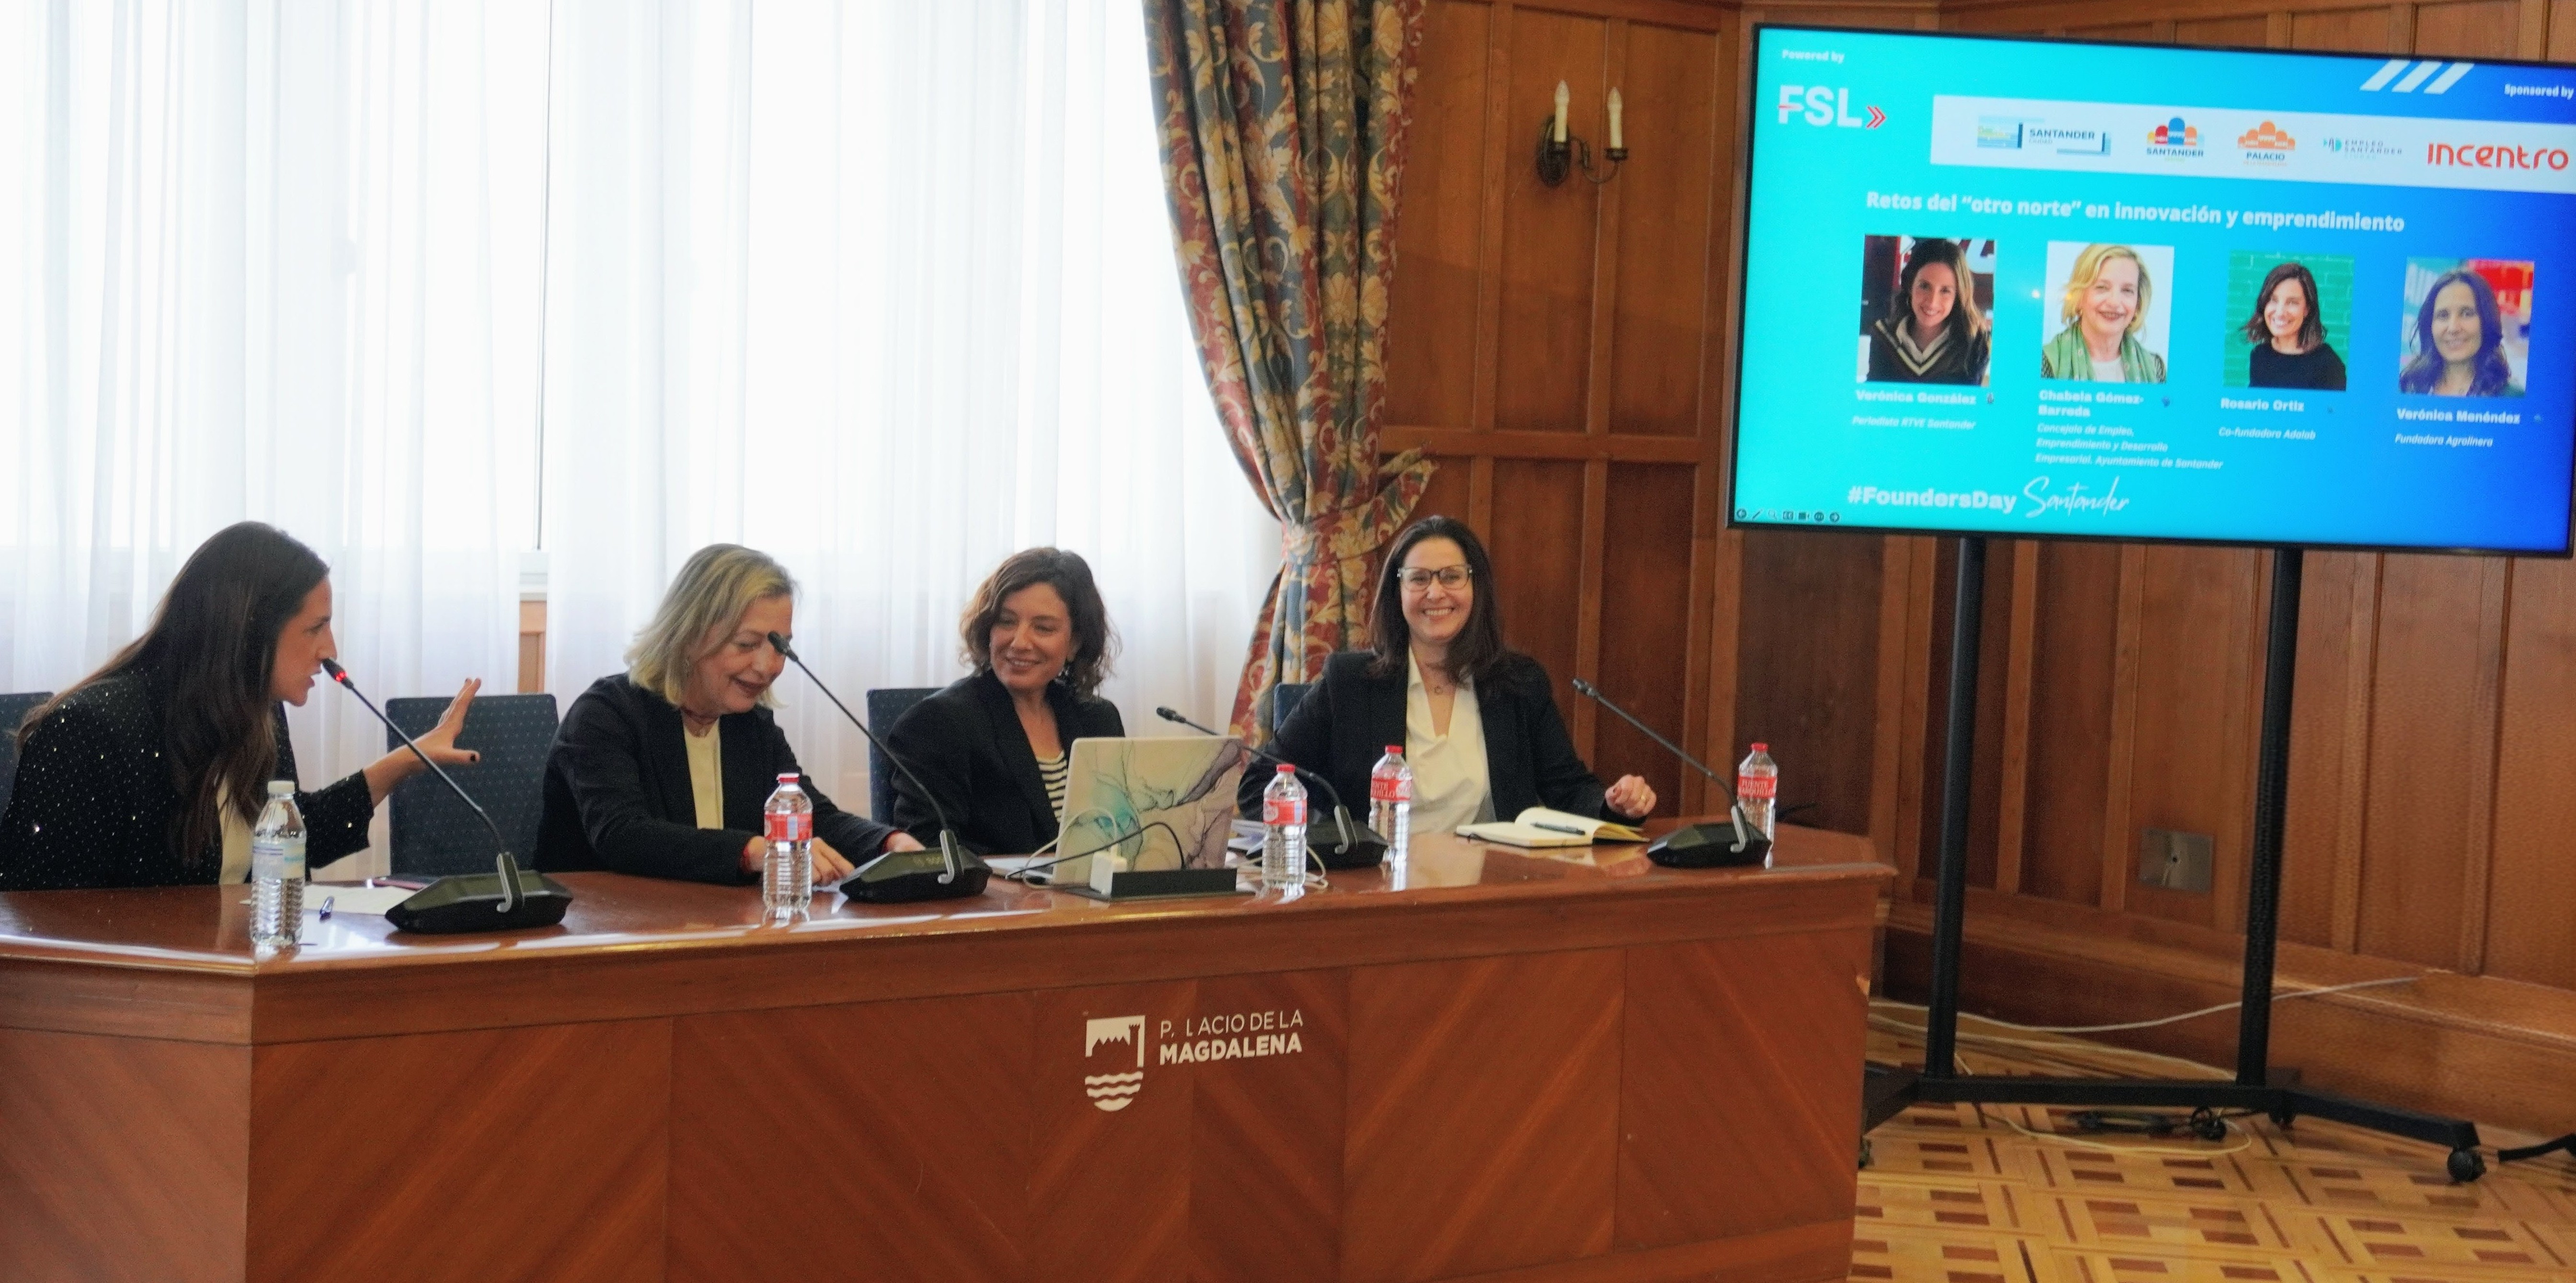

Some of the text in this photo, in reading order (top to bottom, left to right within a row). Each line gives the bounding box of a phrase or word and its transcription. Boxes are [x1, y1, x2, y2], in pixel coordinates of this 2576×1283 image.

[1782, 49, 1844, 64] Powered by
[2504, 83, 2574, 100] Sponsored by
[1778, 84, 1862, 127] FSL
[2030, 129, 2095, 140] SANTANDER
[2147, 148, 2204, 157] SANTANDER
[2246, 152, 2285, 161] PALACIO
[2345, 146, 2402, 155] SANTANDER
[1867, 191, 1922, 210] Retos
[1927, 193, 1957, 211] del
[2085, 204, 2109, 219] en
[2115, 201, 2221, 224] innovación
[2226, 210, 2238, 228] y
[2243, 211, 2405, 232] emprendimiento
[1856, 389, 1976, 405] Verónica González
[2039, 390, 2092, 402] Chabela
[2038, 405, 2091, 417] Barreda
[2221, 397, 2304, 412] Rosario Ortiz
[1852, 416, 1976, 430] Periodista RTVE Santander
[2396, 408, 2520, 424] Verónica Menéndez
[2038, 423, 2082, 435] Concejala
[2085, 425, 2097, 434] de
[2219, 427, 2316, 440] Co-fundadora Adalab
[2036, 438, 2168, 452] Emprendimiento y Desarrollo
[2395, 433, 2493, 448] Fundadora Agrolinera
[2095, 455, 2159, 467] Ayuntamiento
[2162, 458, 2174, 467] de
[2175, 458, 2223, 470] Santander
[1847, 475, 2130, 518] #FoundersDay Santander
[1160, 1009, 1304, 1039] PLACIO DE LA
[1160, 1032, 1303, 1066] MAGDALENA
